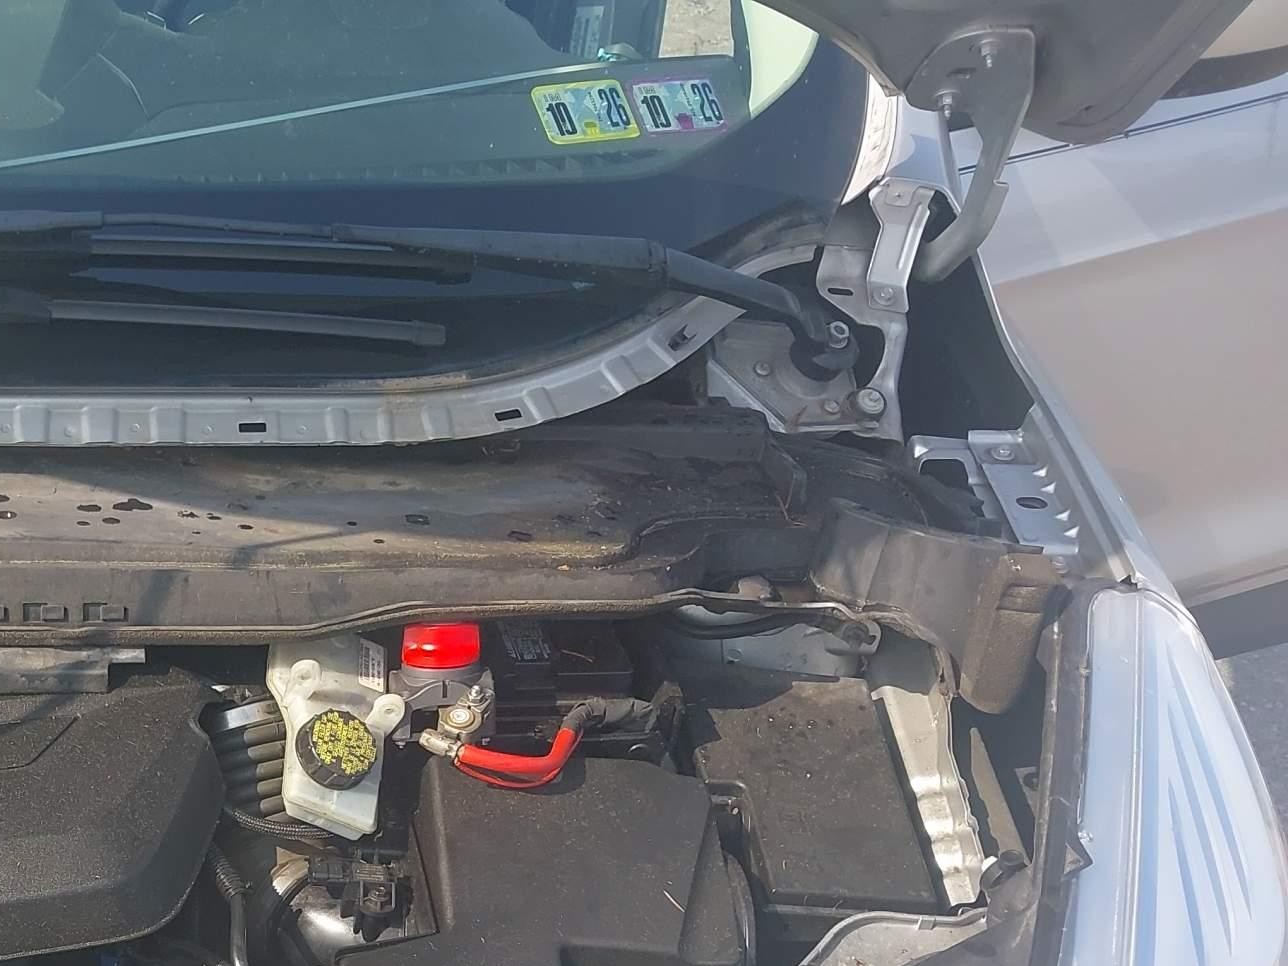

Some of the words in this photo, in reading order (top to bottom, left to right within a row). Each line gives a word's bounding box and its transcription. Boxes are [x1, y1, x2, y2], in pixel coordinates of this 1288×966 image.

[546, 102, 577, 136] 10
[597, 87, 631, 128] 26
[640, 95, 672, 128] 10
[691, 82, 725, 123] 26
